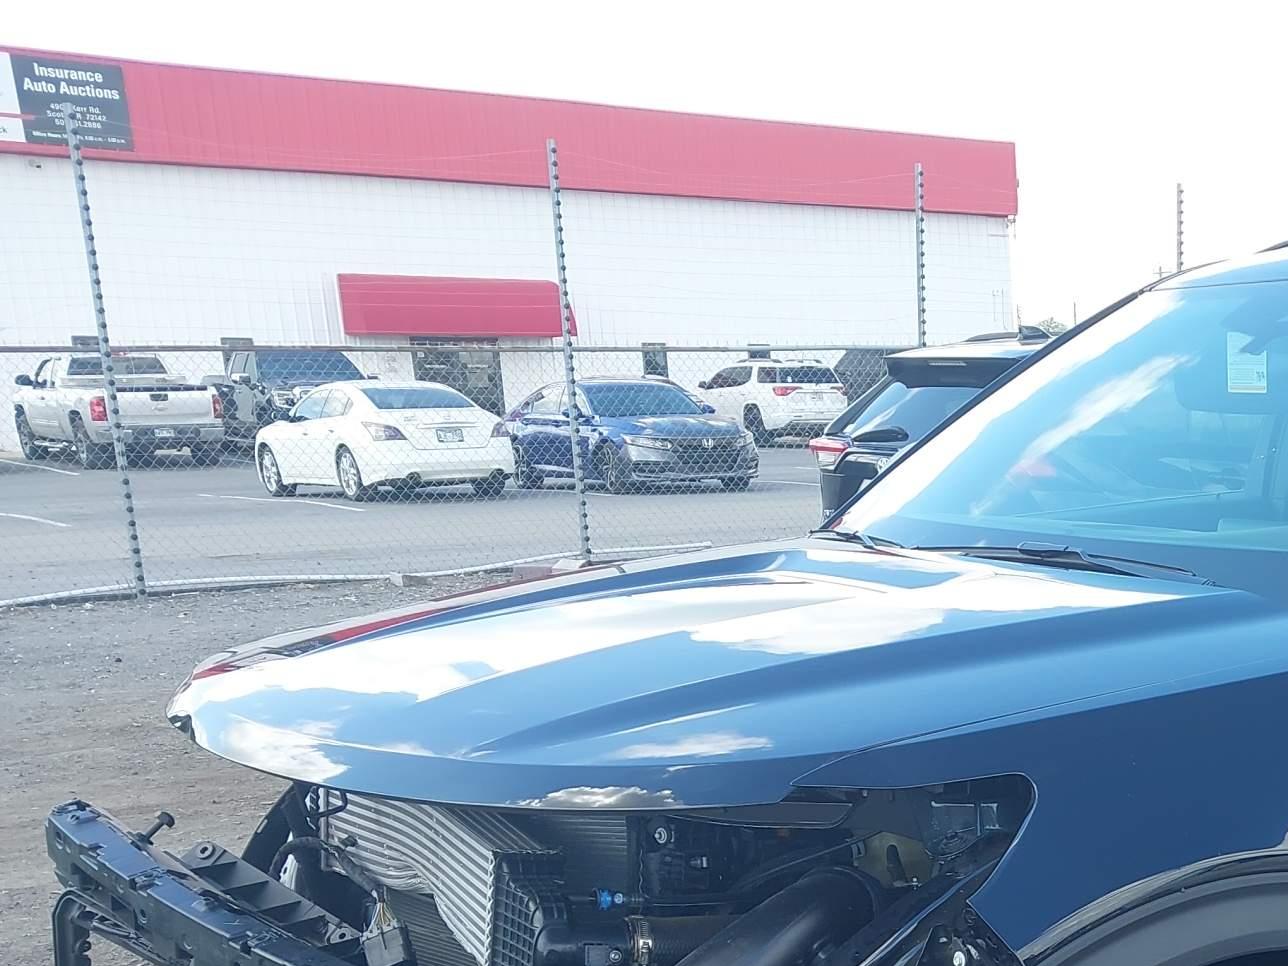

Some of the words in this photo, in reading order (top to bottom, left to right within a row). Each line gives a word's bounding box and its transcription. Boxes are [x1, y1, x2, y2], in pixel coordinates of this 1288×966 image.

[33, 62, 103, 82] Insurance
[23, 77, 56, 93] Auto
[60, 81, 120, 100] Auctions
